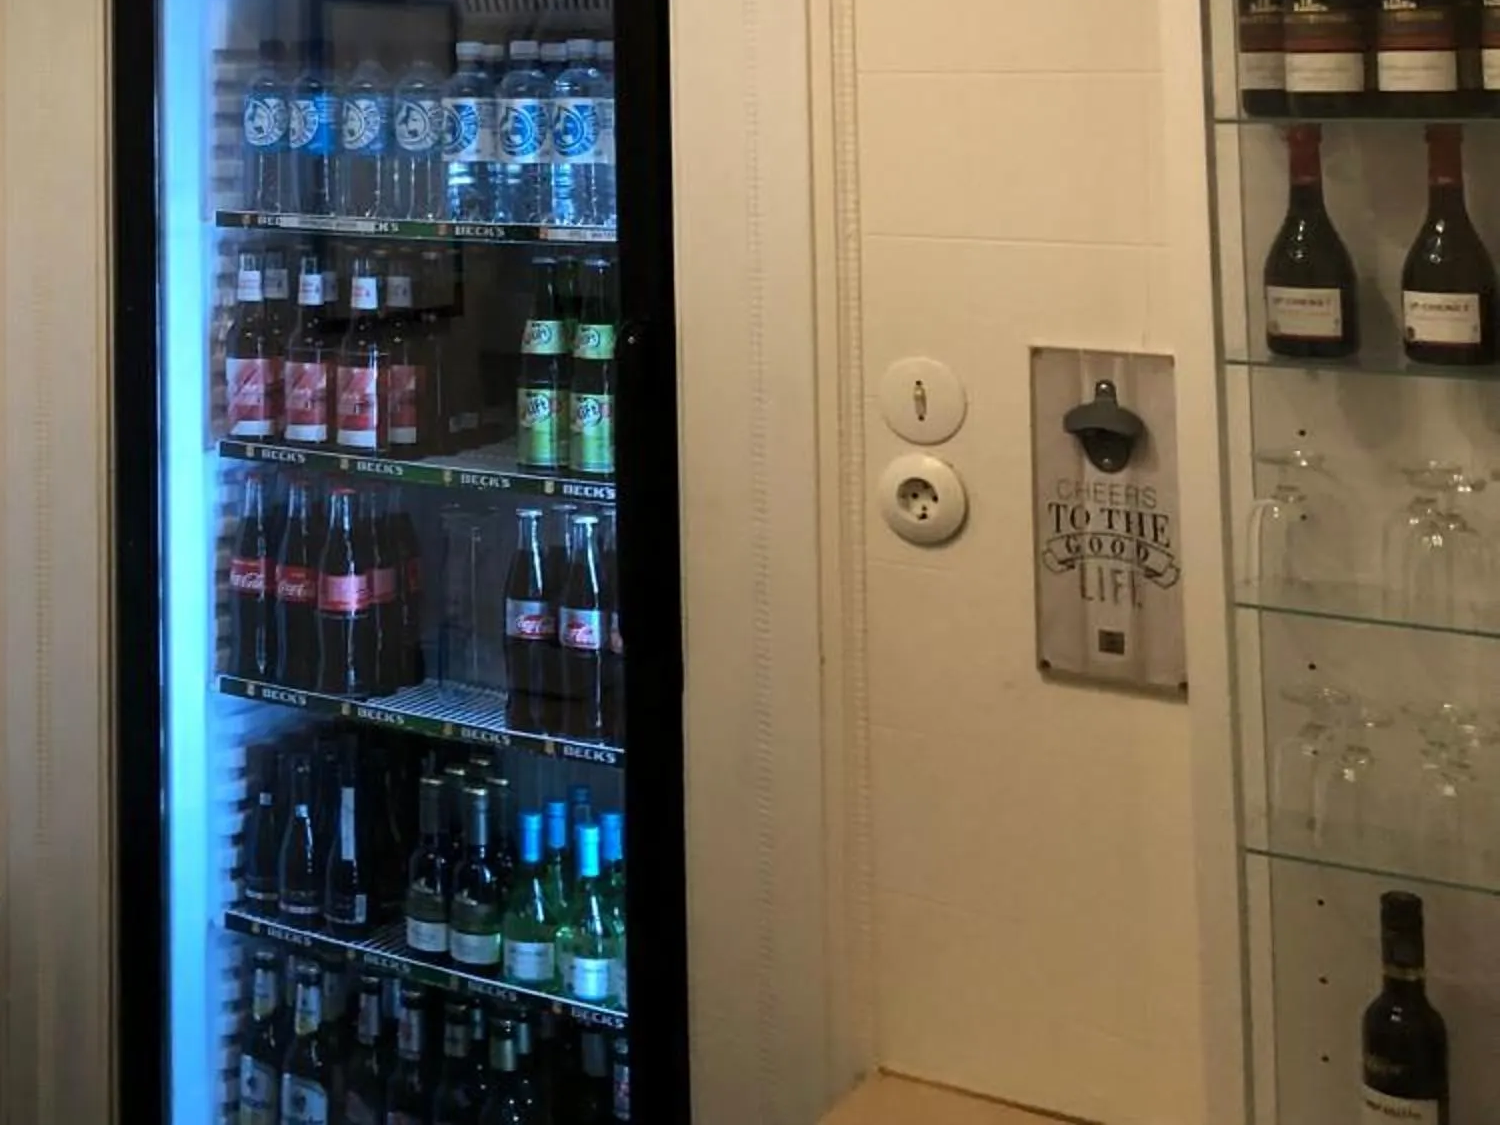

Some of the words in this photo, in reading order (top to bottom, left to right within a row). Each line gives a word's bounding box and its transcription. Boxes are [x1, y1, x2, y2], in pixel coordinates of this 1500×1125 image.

[1055, 478, 1158, 510] CHEERS
[1048, 502, 1091, 534] TO
[1099, 507, 1171, 550] THE
[1064, 535, 1150, 564] GOOD
